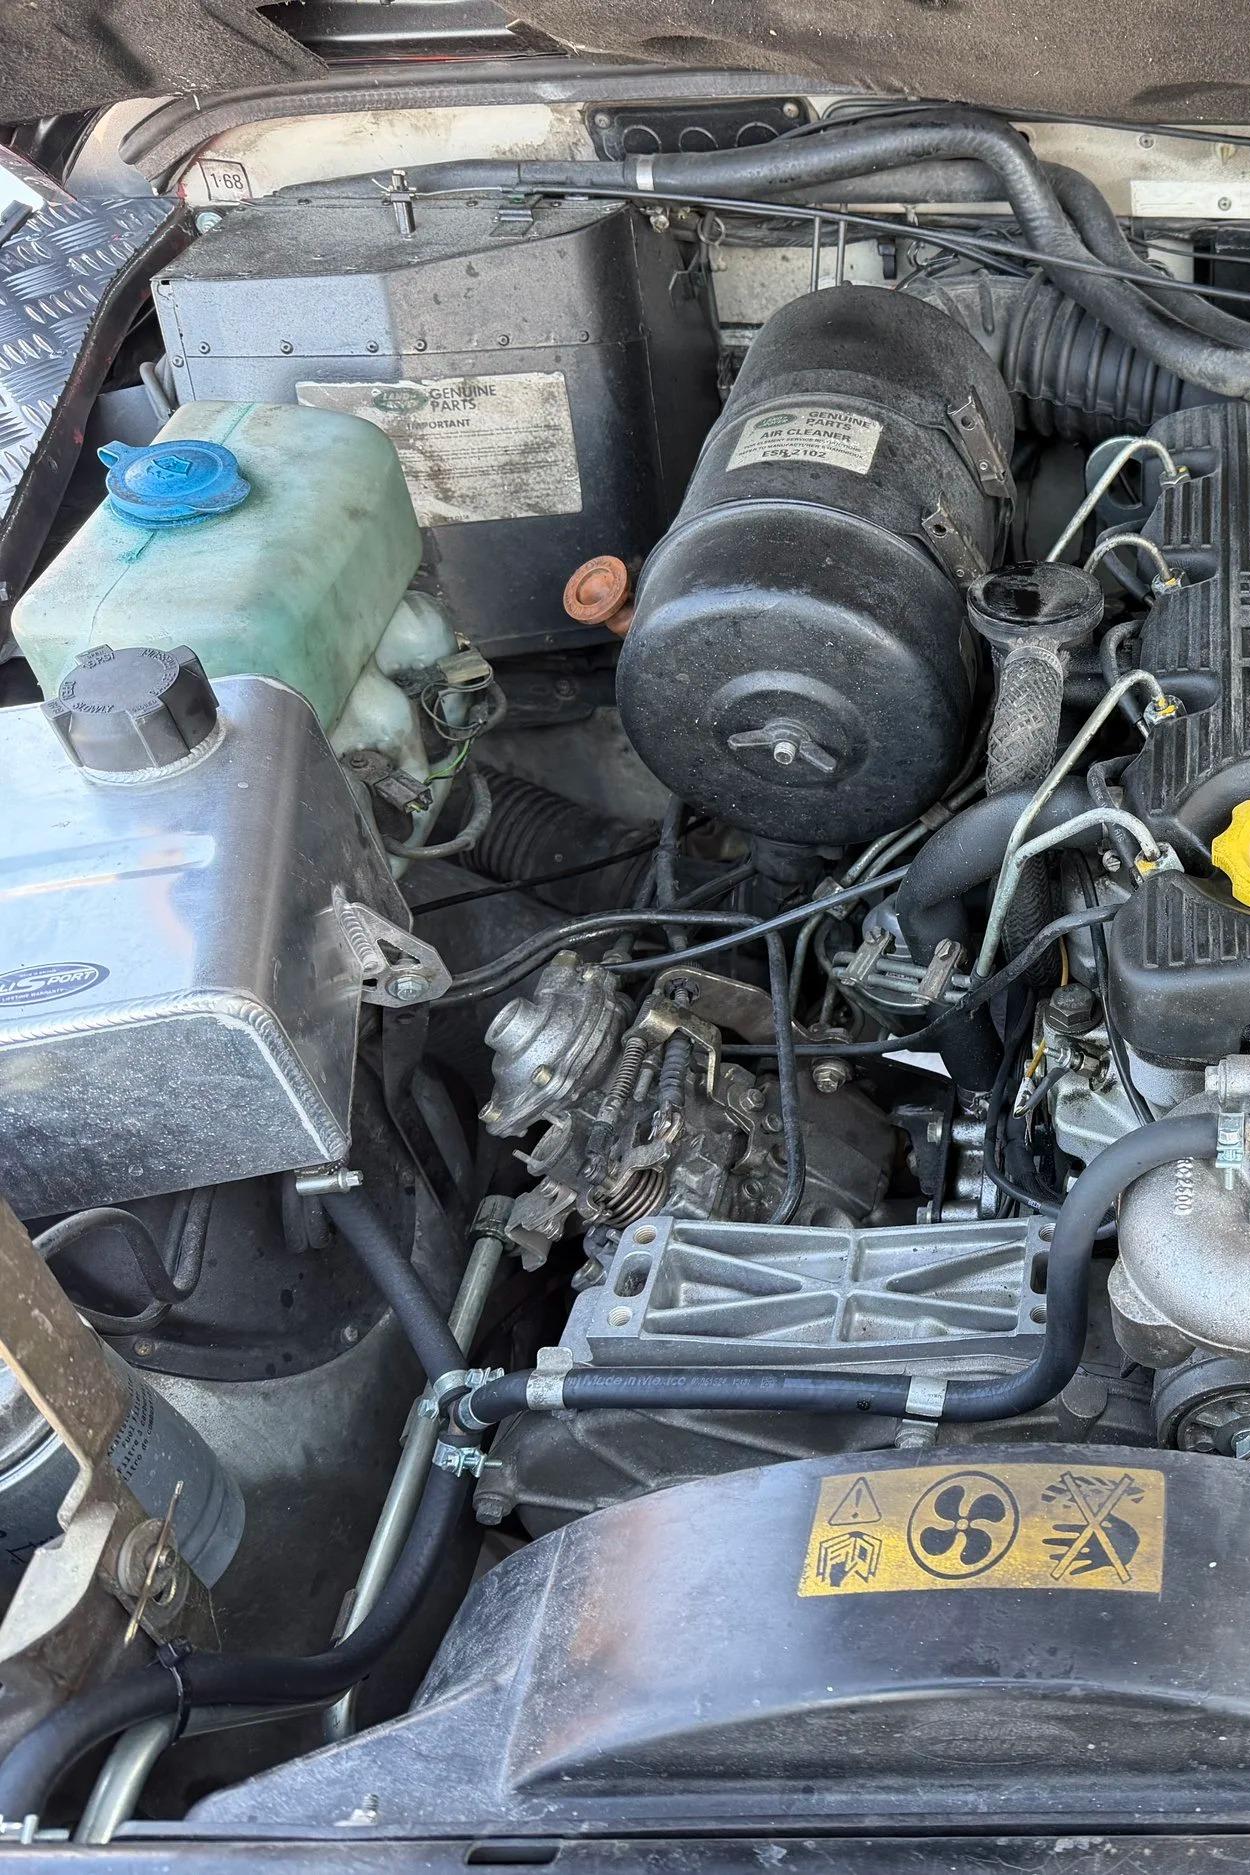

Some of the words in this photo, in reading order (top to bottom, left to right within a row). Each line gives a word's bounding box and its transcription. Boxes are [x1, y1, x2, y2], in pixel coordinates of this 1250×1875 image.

[428, 384, 497, 400] GENUINE
[429, 400, 477, 413] PARTS
[405, 418, 471, 431] IMPORTANT
[805, 418, 853, 431] PARTS
[808, 411, 872, 430] GENUINE
[759, 429, 783, 440] AIR
[786, 428, 852, 442] CLEANER
[122, 1453, 143, 1482] iltro
